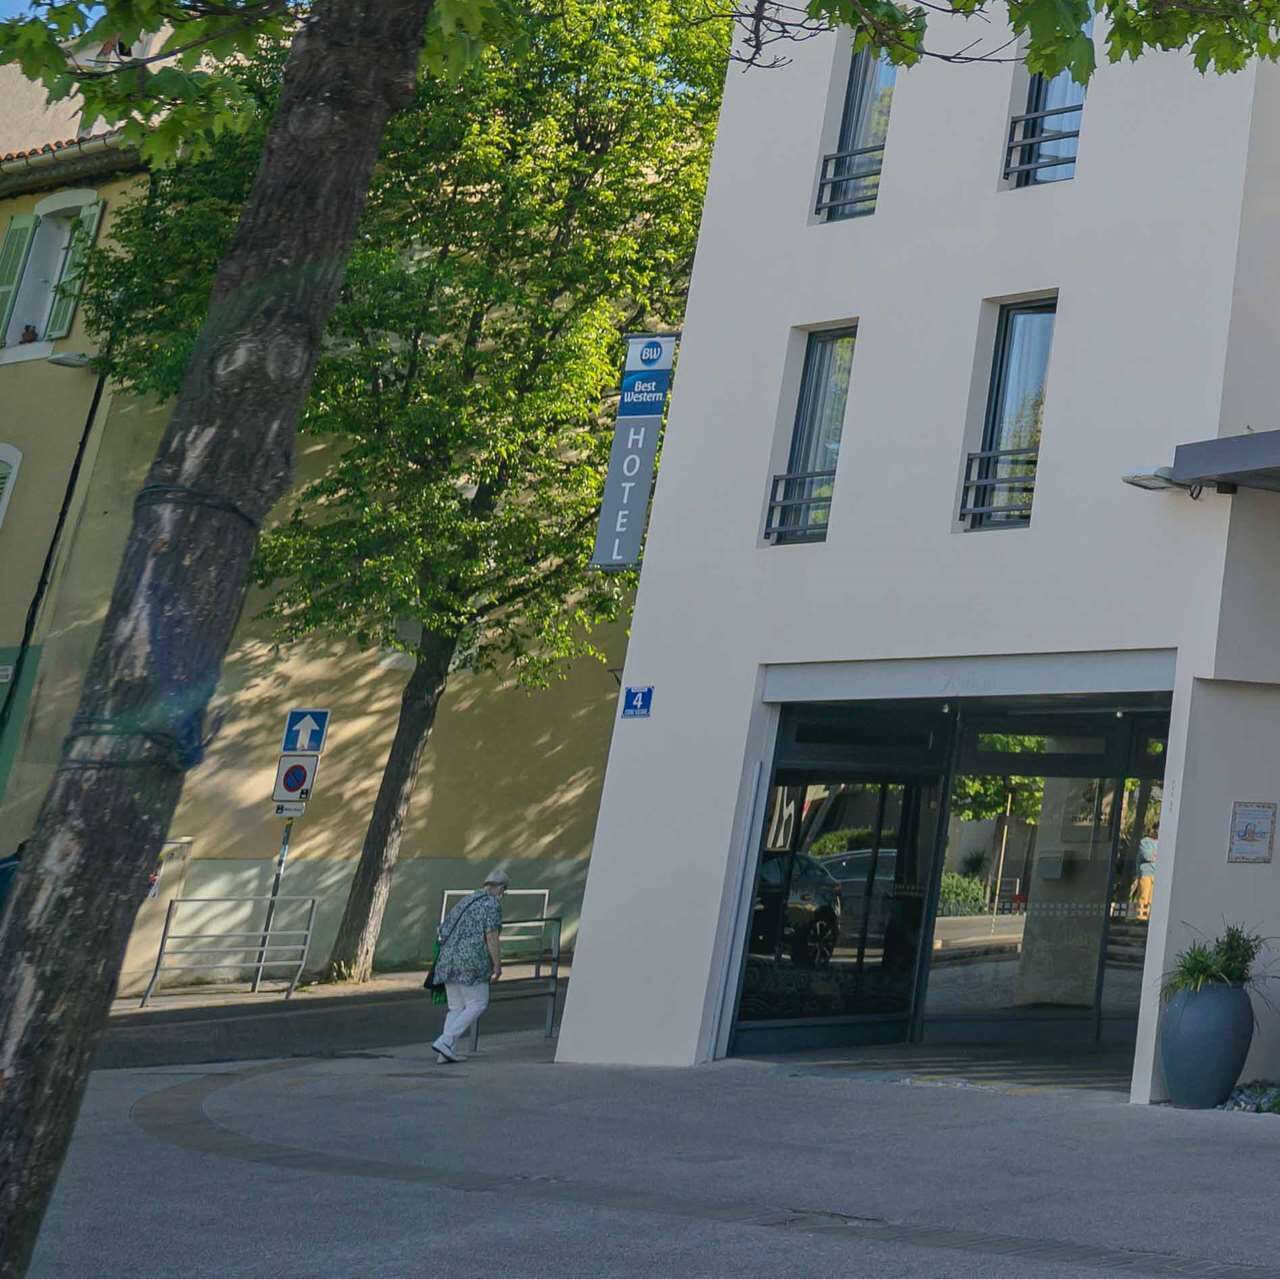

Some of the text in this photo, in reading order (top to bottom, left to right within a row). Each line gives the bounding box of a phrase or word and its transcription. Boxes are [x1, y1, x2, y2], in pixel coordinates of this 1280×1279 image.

[642, 347, 661, 360] BW
[634, 381, 656, 392] Best
[624, 391, 663, 403] Western
[612, 427, 646, 560] HOTEL
[632, 692, 643, 709] 4
